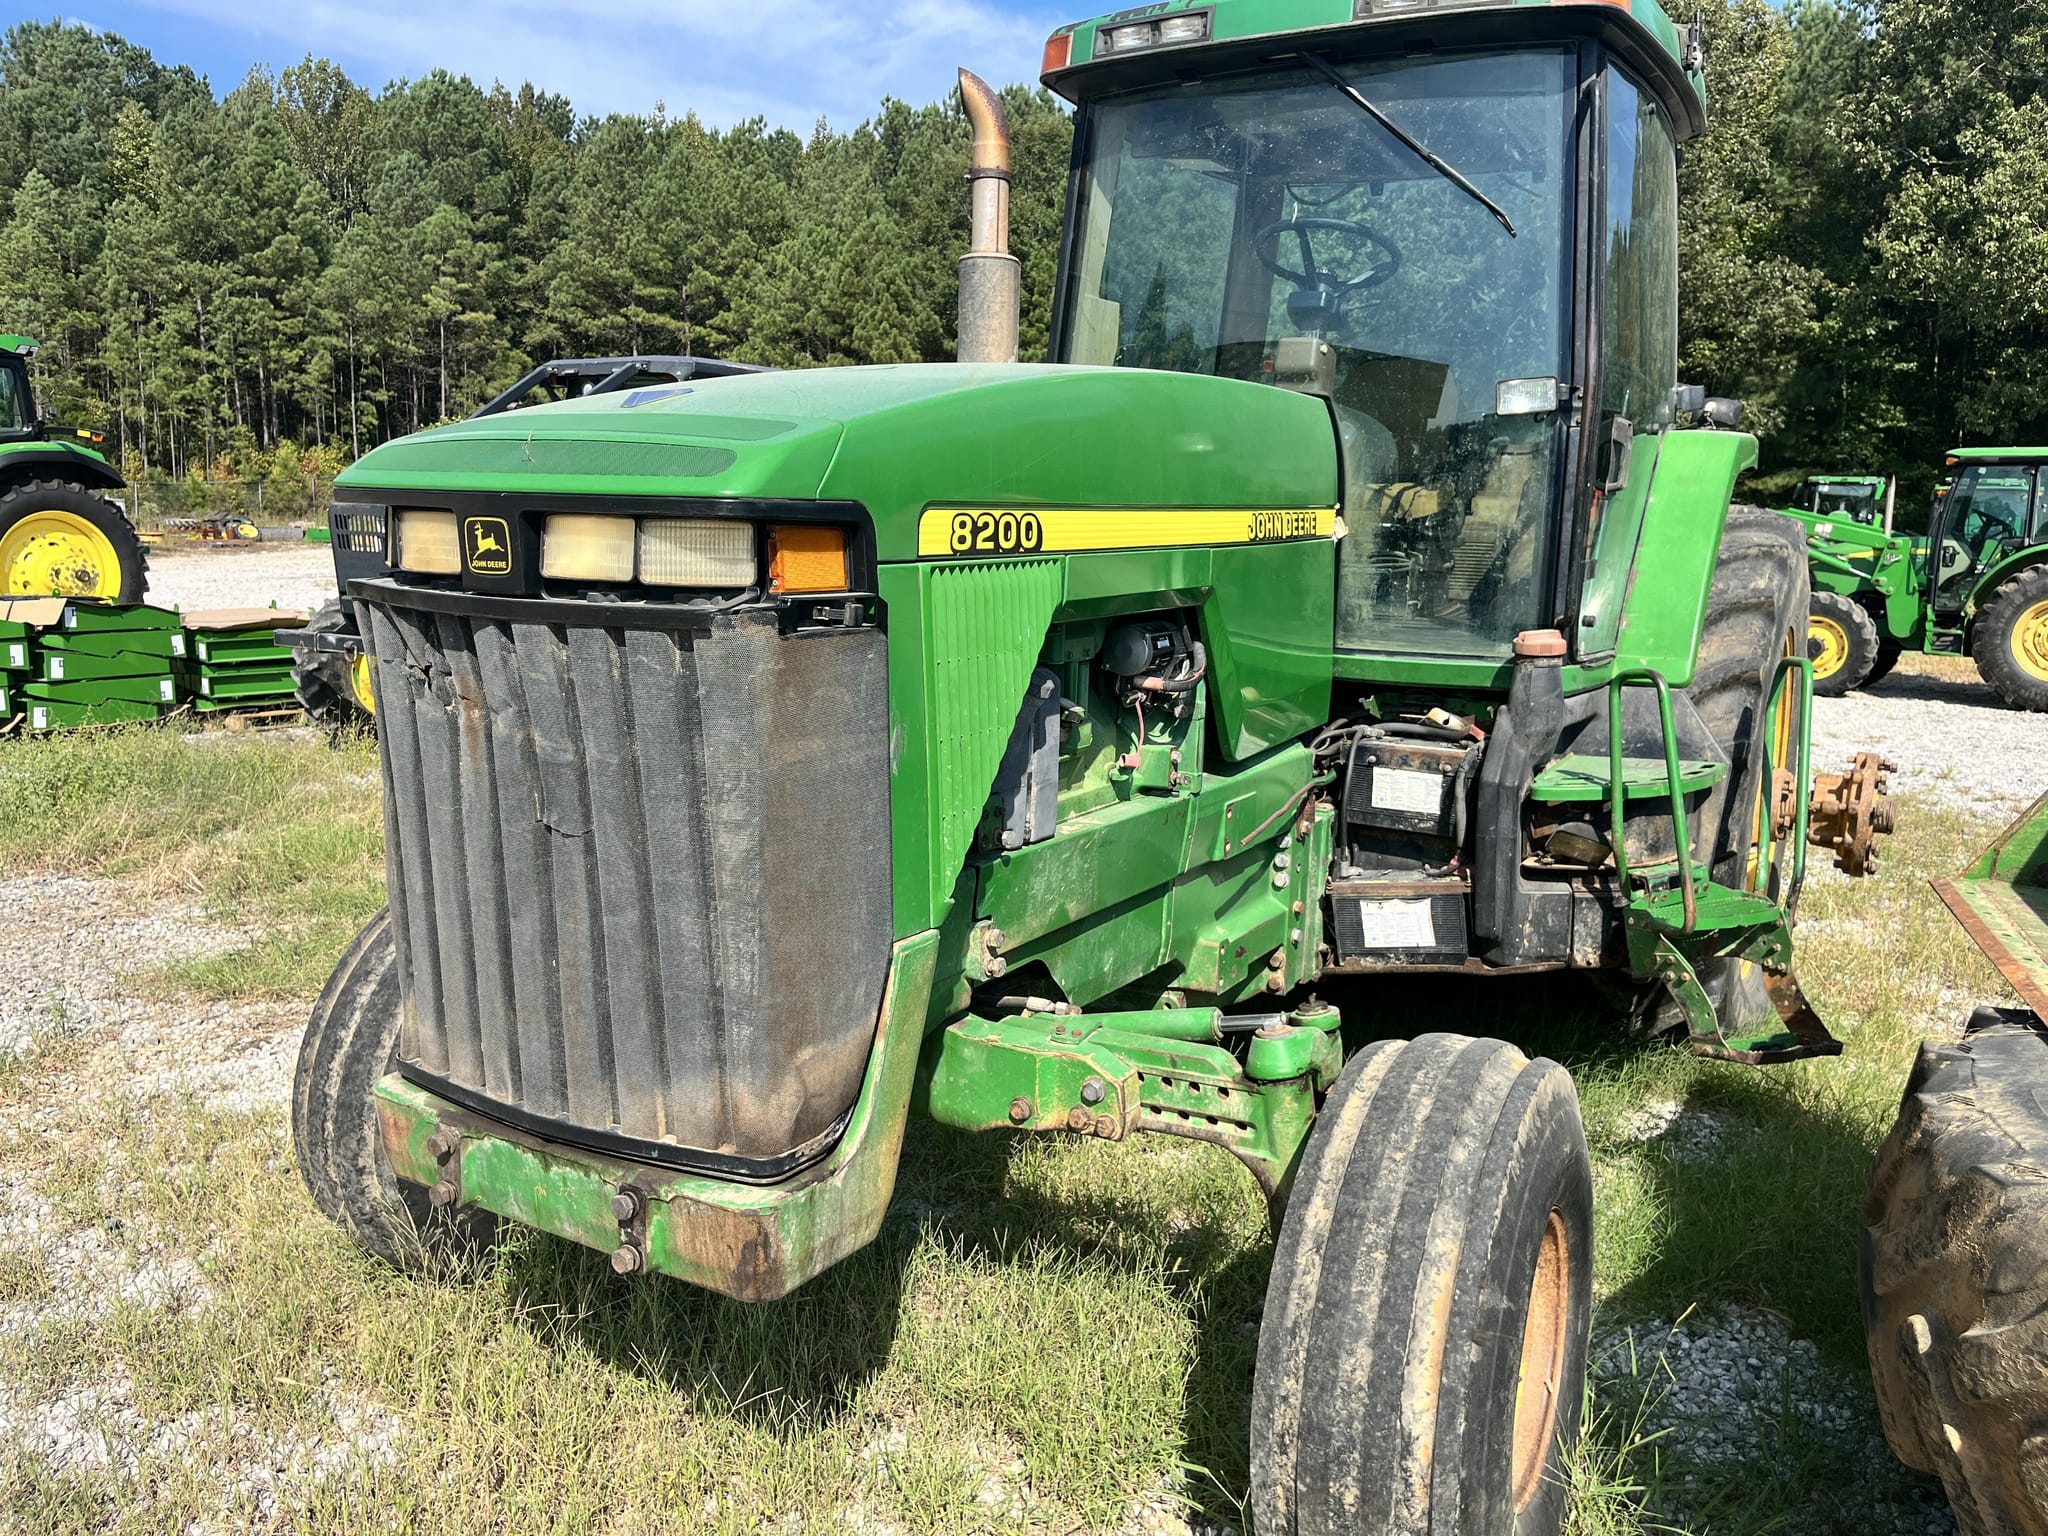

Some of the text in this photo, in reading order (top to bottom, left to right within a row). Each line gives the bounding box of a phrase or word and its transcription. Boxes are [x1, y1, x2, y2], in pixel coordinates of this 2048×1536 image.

[950, 512, 1043, 553] 8200
[1248, 511, 1317, 540] JOHN DEERE
[472, 560, 507, 569] JOHN DEERE
